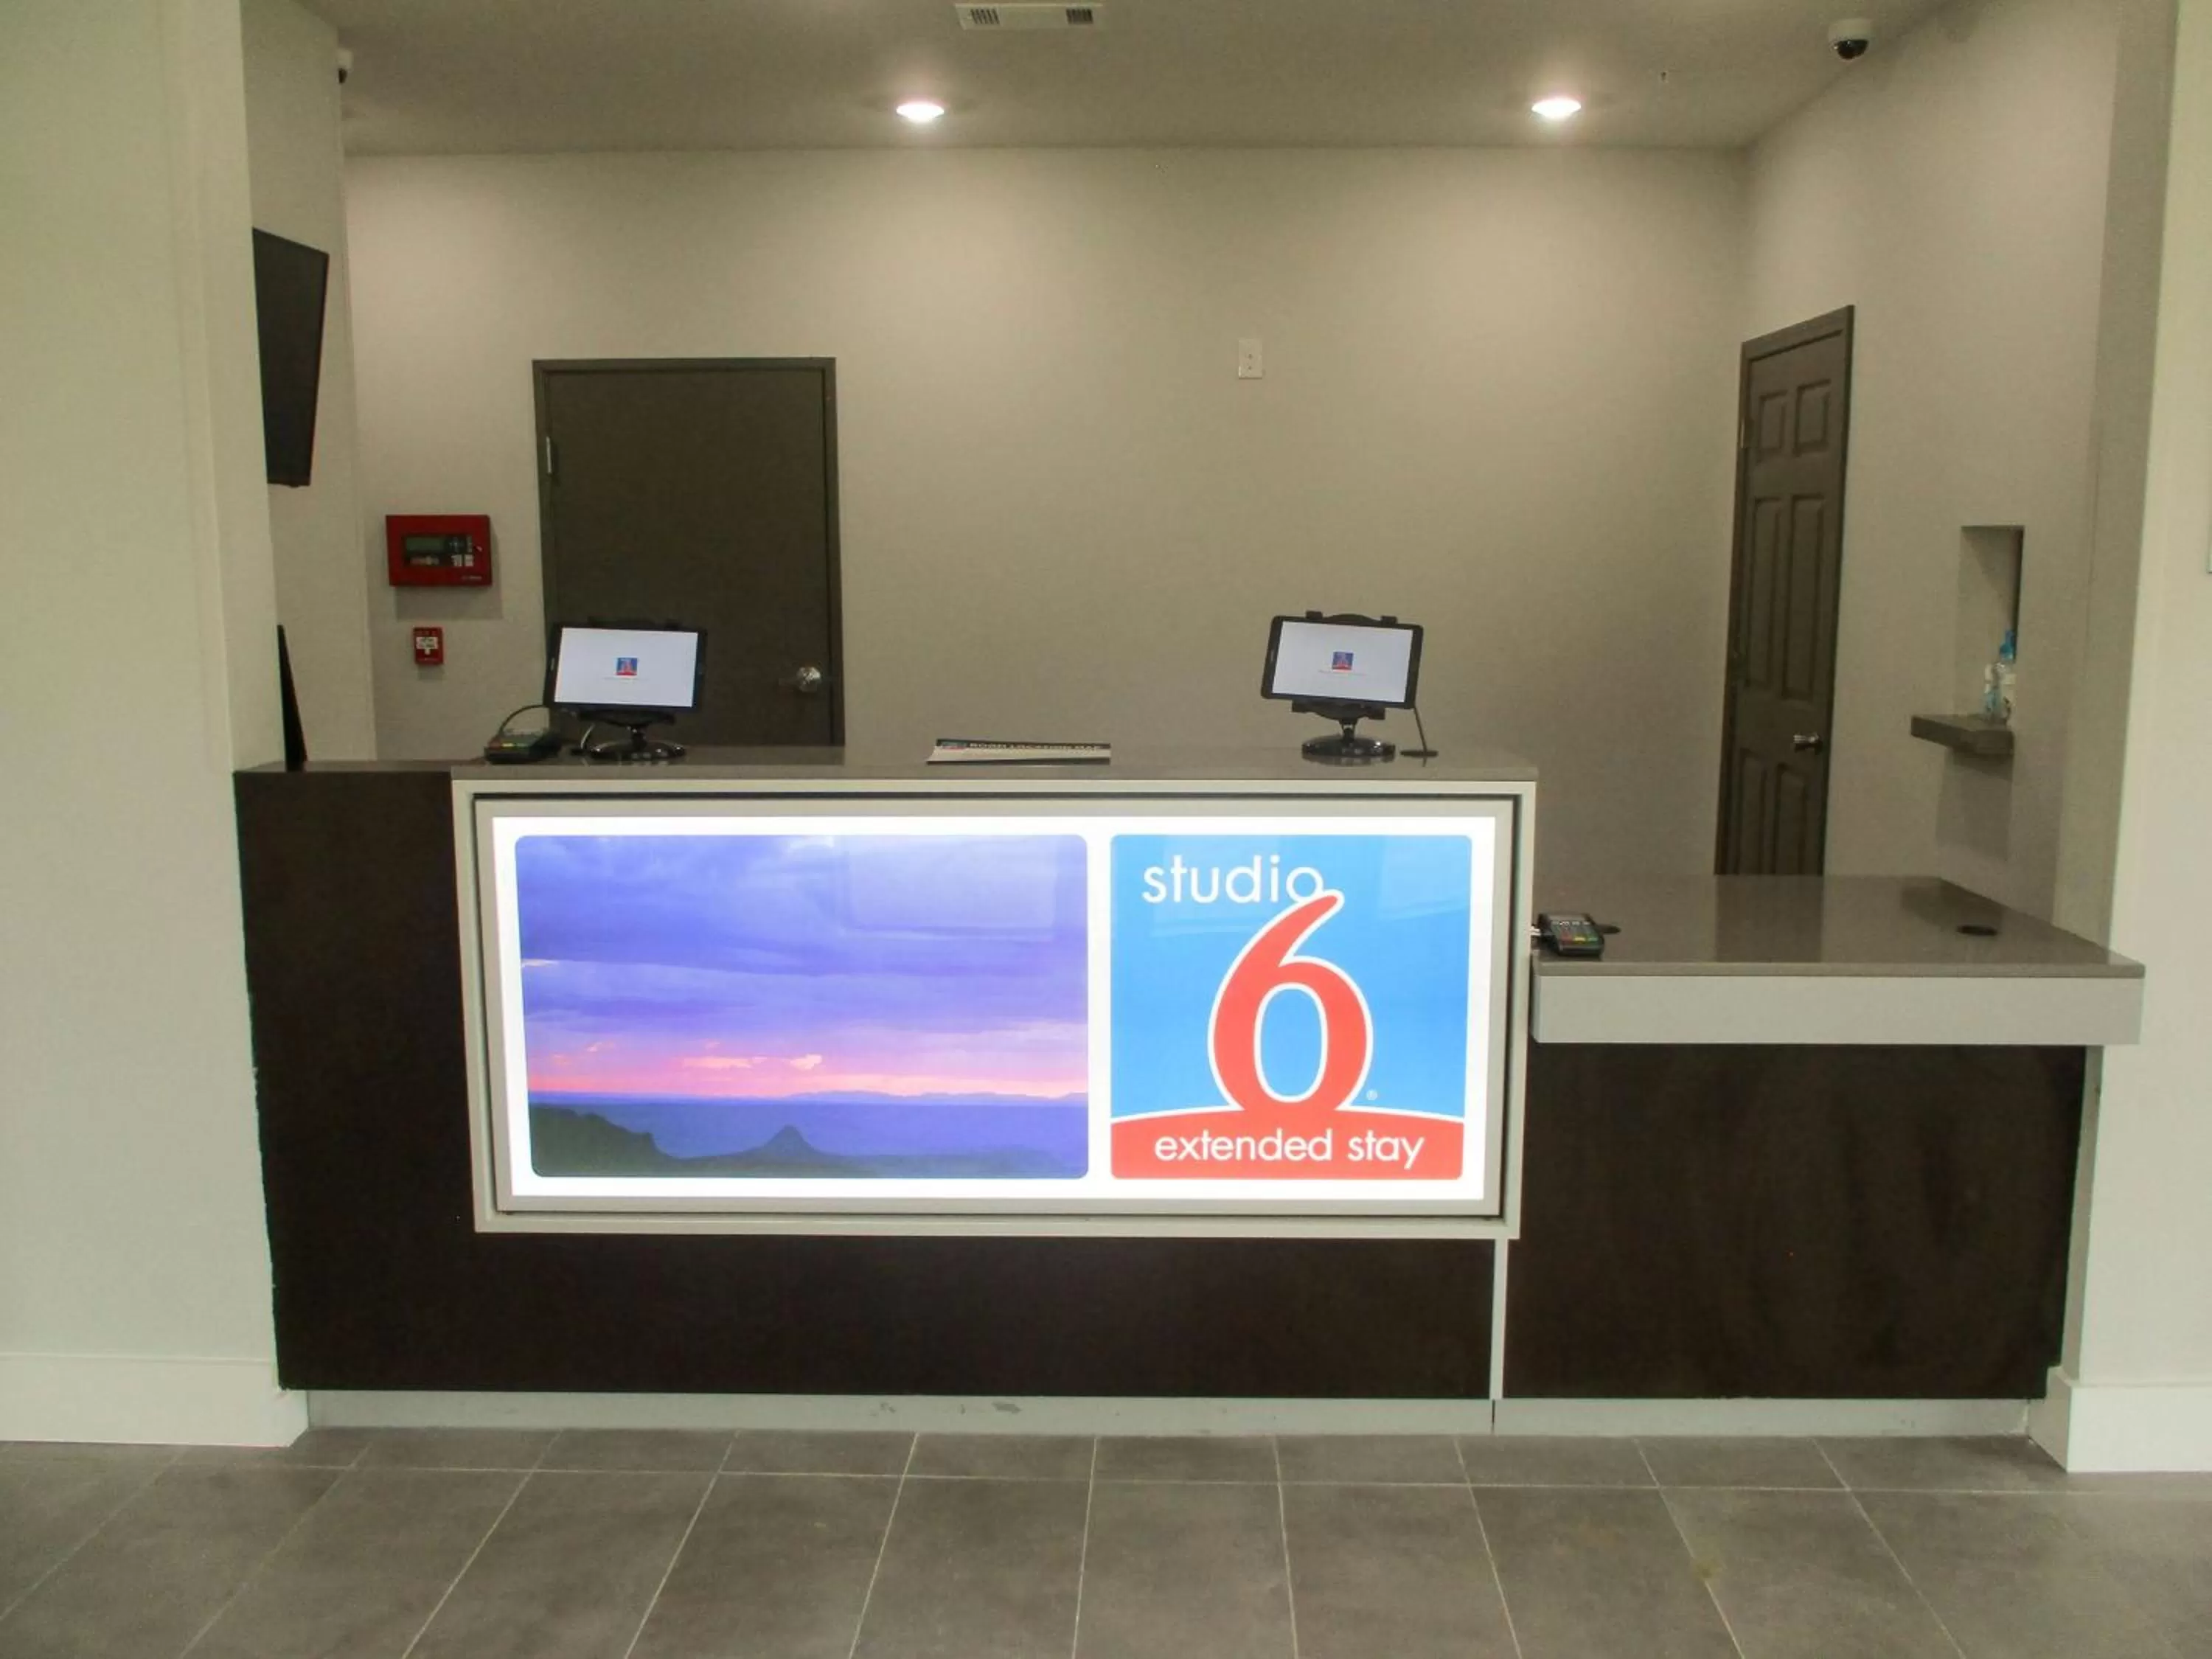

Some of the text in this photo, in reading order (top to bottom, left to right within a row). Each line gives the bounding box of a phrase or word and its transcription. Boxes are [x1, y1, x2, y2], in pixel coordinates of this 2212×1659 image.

[1141, 855, 1324, 904] studio
[1208, 889, 1374, 1110] 6
[1154, 1128, 1425, 1170] extended stay
